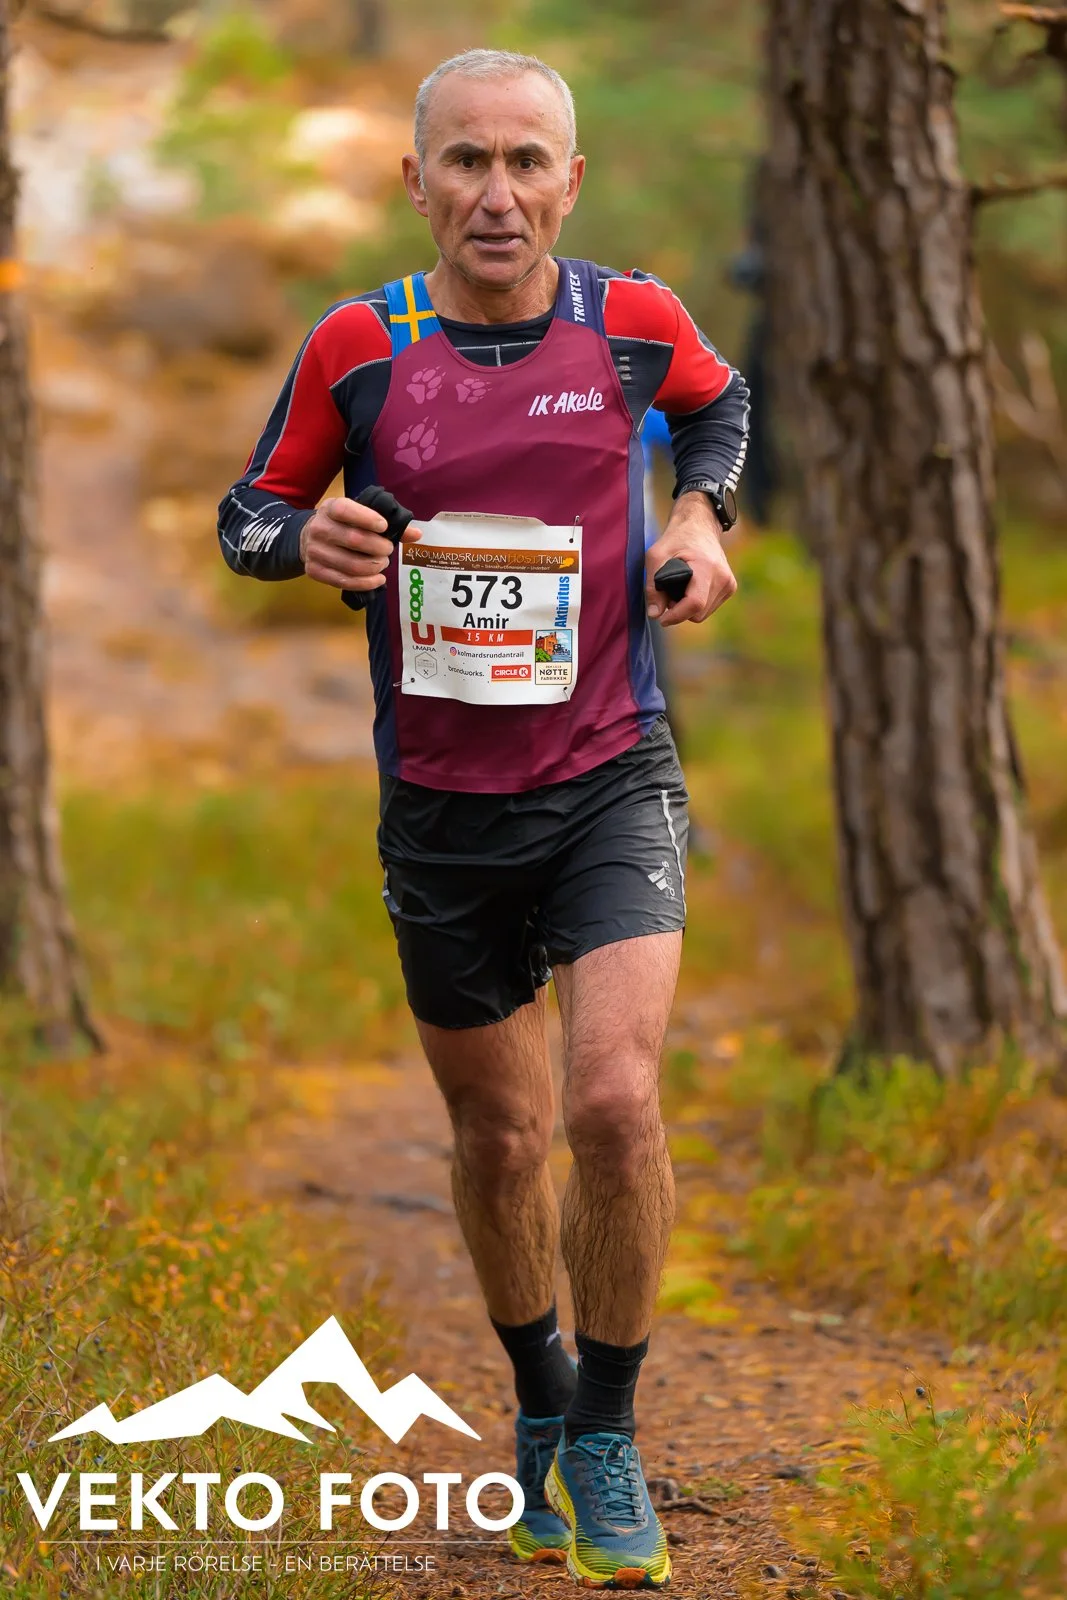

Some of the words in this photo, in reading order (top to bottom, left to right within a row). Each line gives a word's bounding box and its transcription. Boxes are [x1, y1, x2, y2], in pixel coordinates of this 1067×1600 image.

[569, 270, 586, 322] TRIMTEK
[528, 395, 553, 417] IK
[553, 387, 605, 414] Akele
[410, 568, 424, 623] coop
[451, 574, 523, 610] 573
[554, 576, 570, 628] Aktivitus
[463, 612, 510, 629] Amir
[466, 632, 481, 642] 15
[488, 632, 504, 642] KM
[412, 645, 437, 653] UMARA
[457, 649, 524, 659] kolmardsrundantrail
[539, 668, 568, 676] NØTTE
